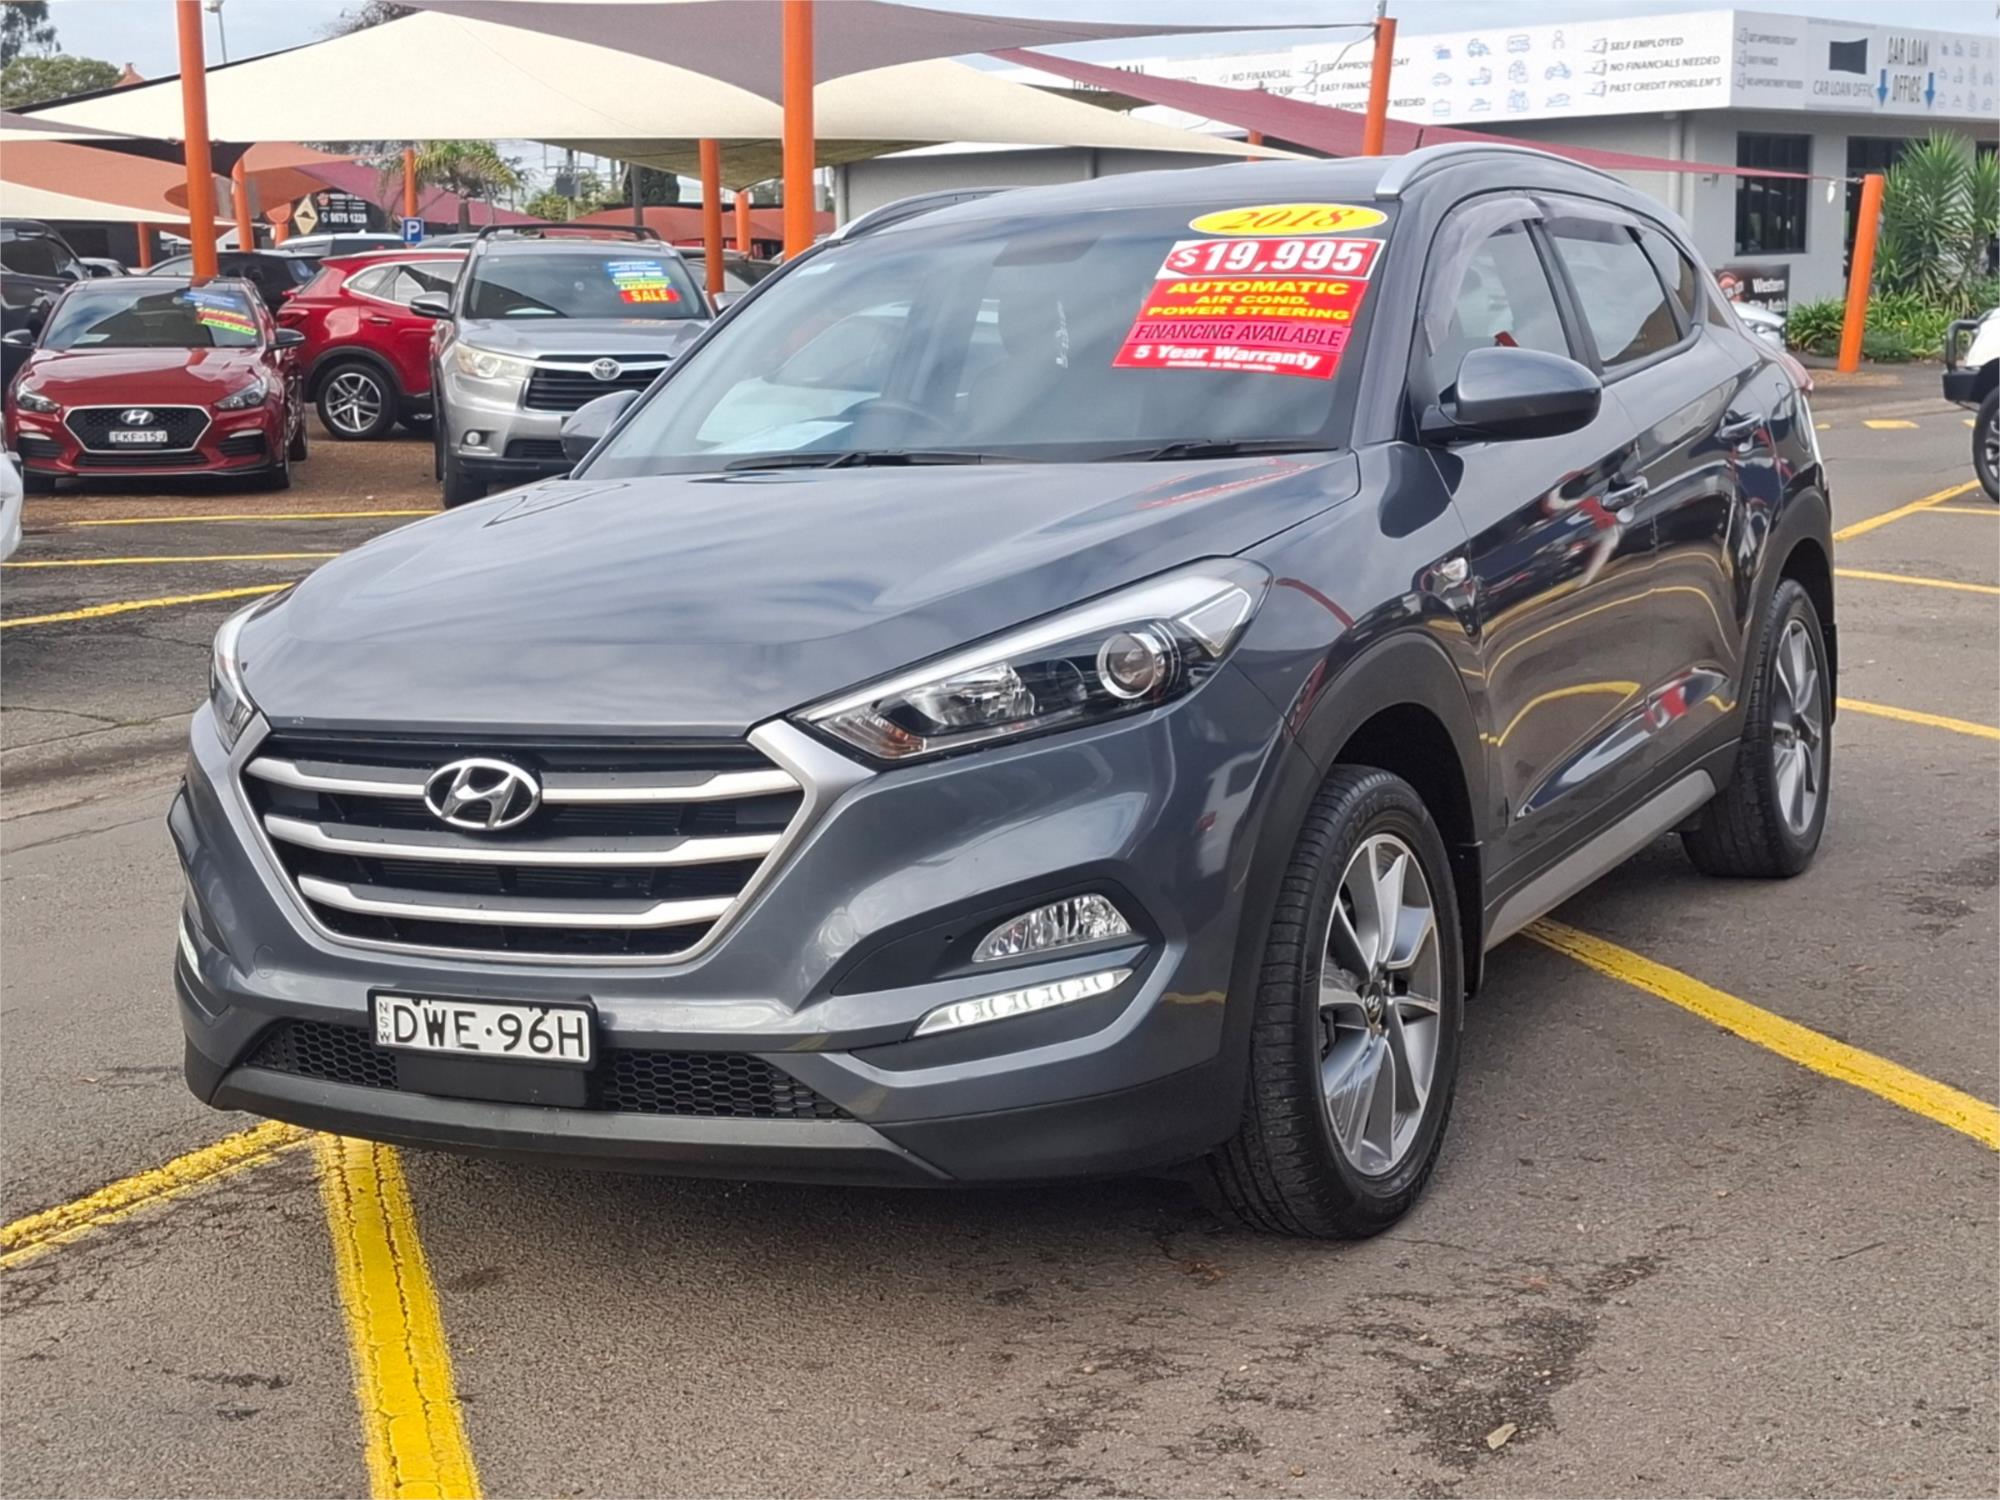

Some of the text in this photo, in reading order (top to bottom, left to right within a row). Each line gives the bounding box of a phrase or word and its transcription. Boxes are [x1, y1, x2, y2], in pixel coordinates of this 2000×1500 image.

[1610, 37, 1684, 51] SELF EMPLOYED
[1610, 56, 1721, 72] NO FINANCIALS NEEDED
[1610, 83, 1631, 93] PAST
[1633, 81, 1667, 92] CREDIT
[1893, 74, 1921, 102] OFFICE
[1393, 98, 1426, 107] NEEDED
[1222, 209, 1354, 230] 2018
[407, 221, 420, 240] P
[1166, 280, 1350, 295] AUTOMATIC
[630, 289, 669, 302] SALE
[1196, 295, 1310, 305] AIR COND.
[1148, 307, 1350, 320] POWER STEERING
[1134, 324, 1343, 347] FINANCING AVAILABLE
[1134, 345, 1321, 369] 5 Year Warranty
